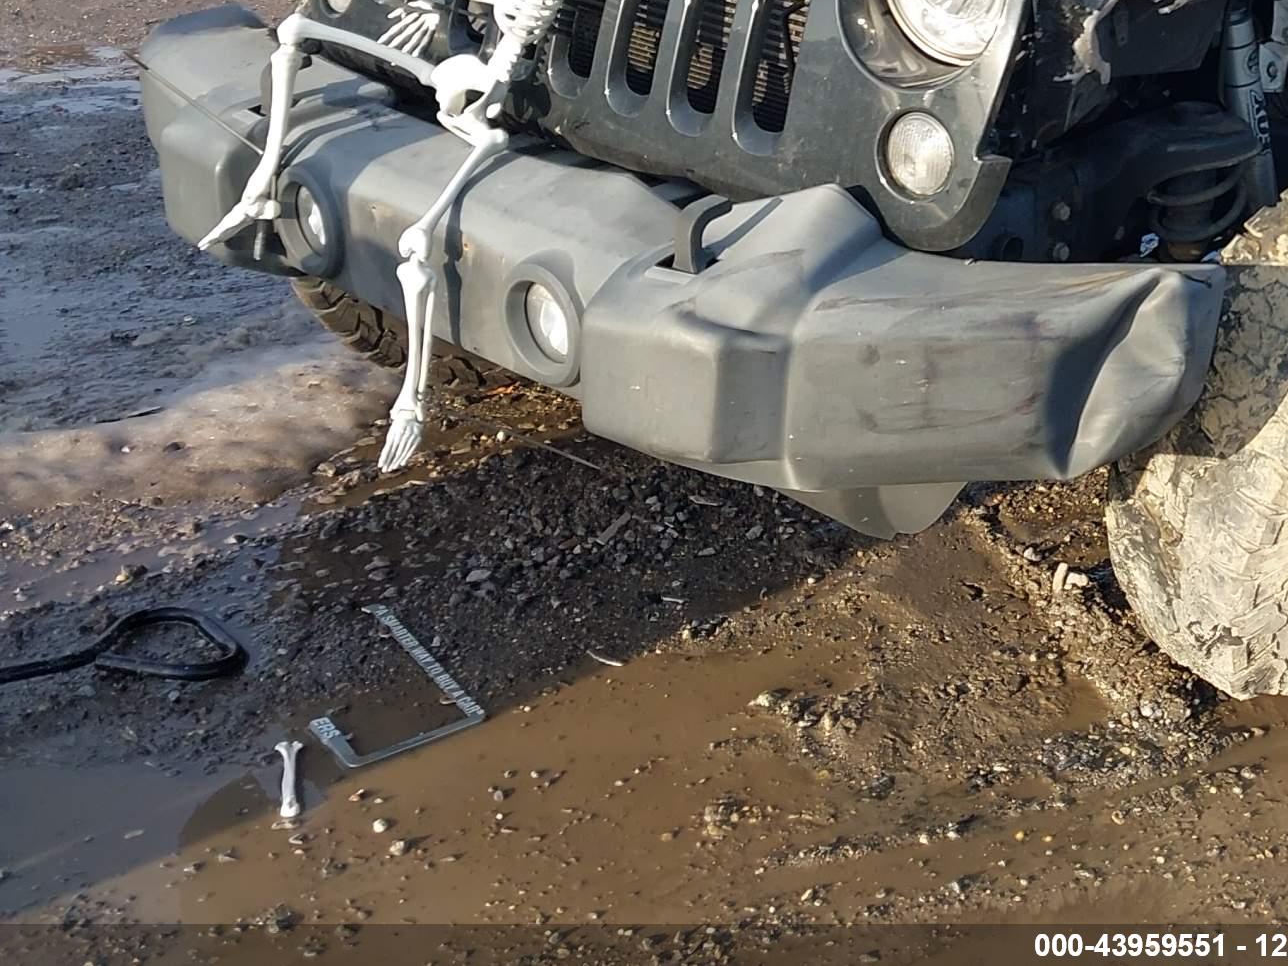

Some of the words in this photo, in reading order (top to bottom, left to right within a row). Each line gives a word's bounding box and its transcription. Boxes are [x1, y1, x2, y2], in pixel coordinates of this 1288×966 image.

[382, 615, 420, 649] SMARTER
[411, 645, 436, 664] WAY
[426, 662, 445, 675] TO
[435, 673, 460, 691] BUY
